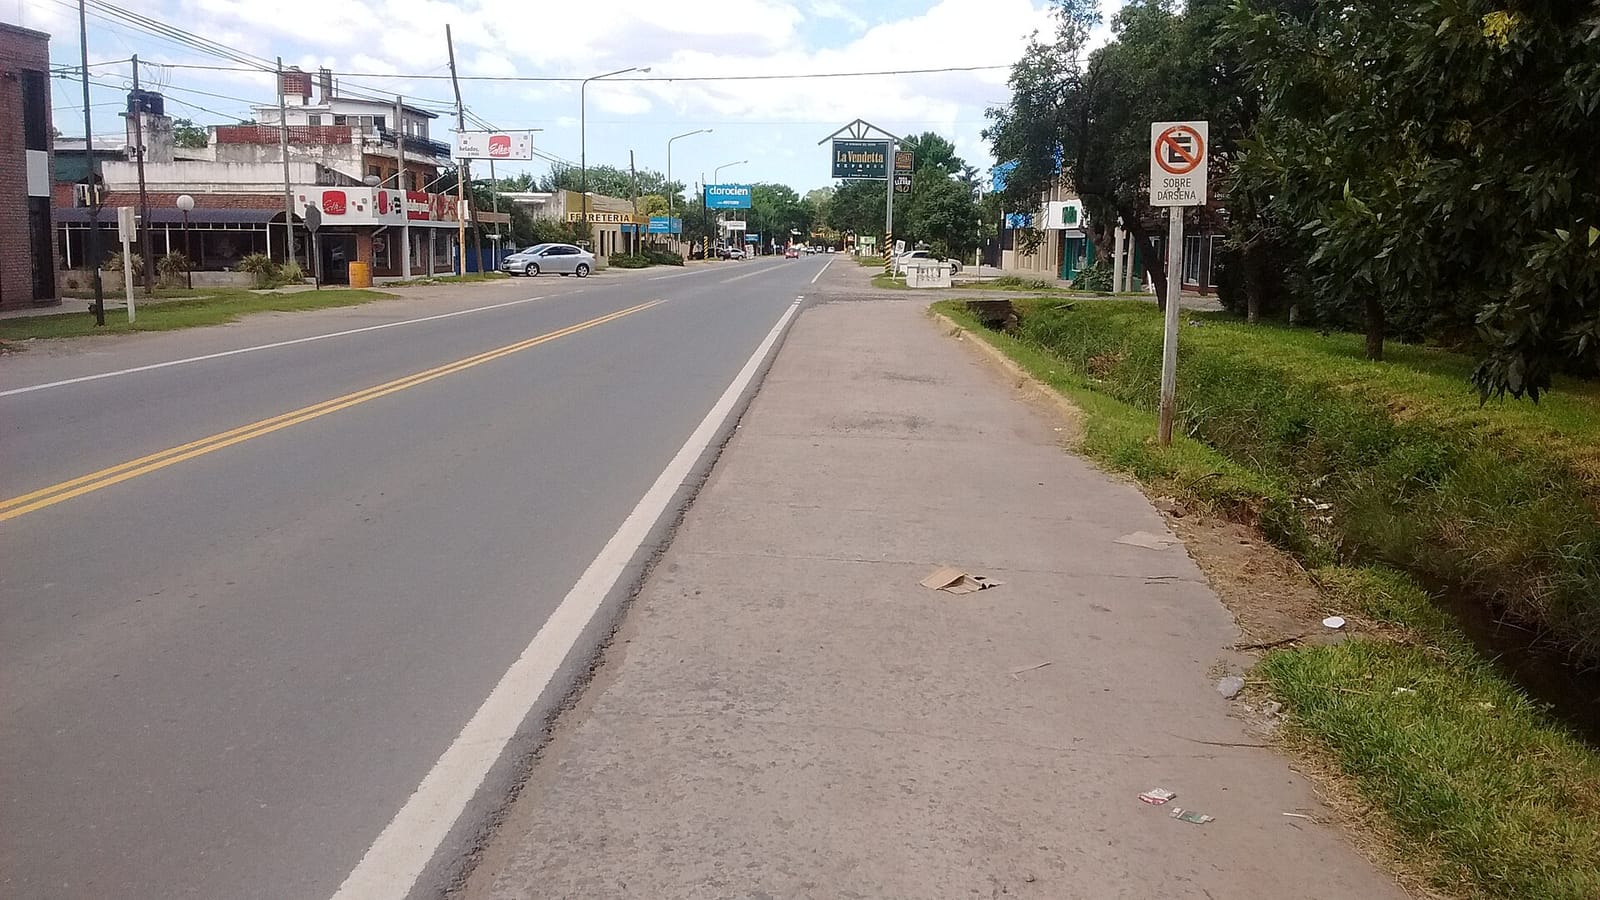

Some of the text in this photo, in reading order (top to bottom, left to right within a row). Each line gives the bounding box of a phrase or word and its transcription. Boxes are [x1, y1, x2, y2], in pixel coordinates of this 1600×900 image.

[836, 150, 847, 163] La
[847, 150, 884, 163] Vendetta
[1163, 178, 1191, 188] SOBRE
[709, 186, 748, 195] clorocien
